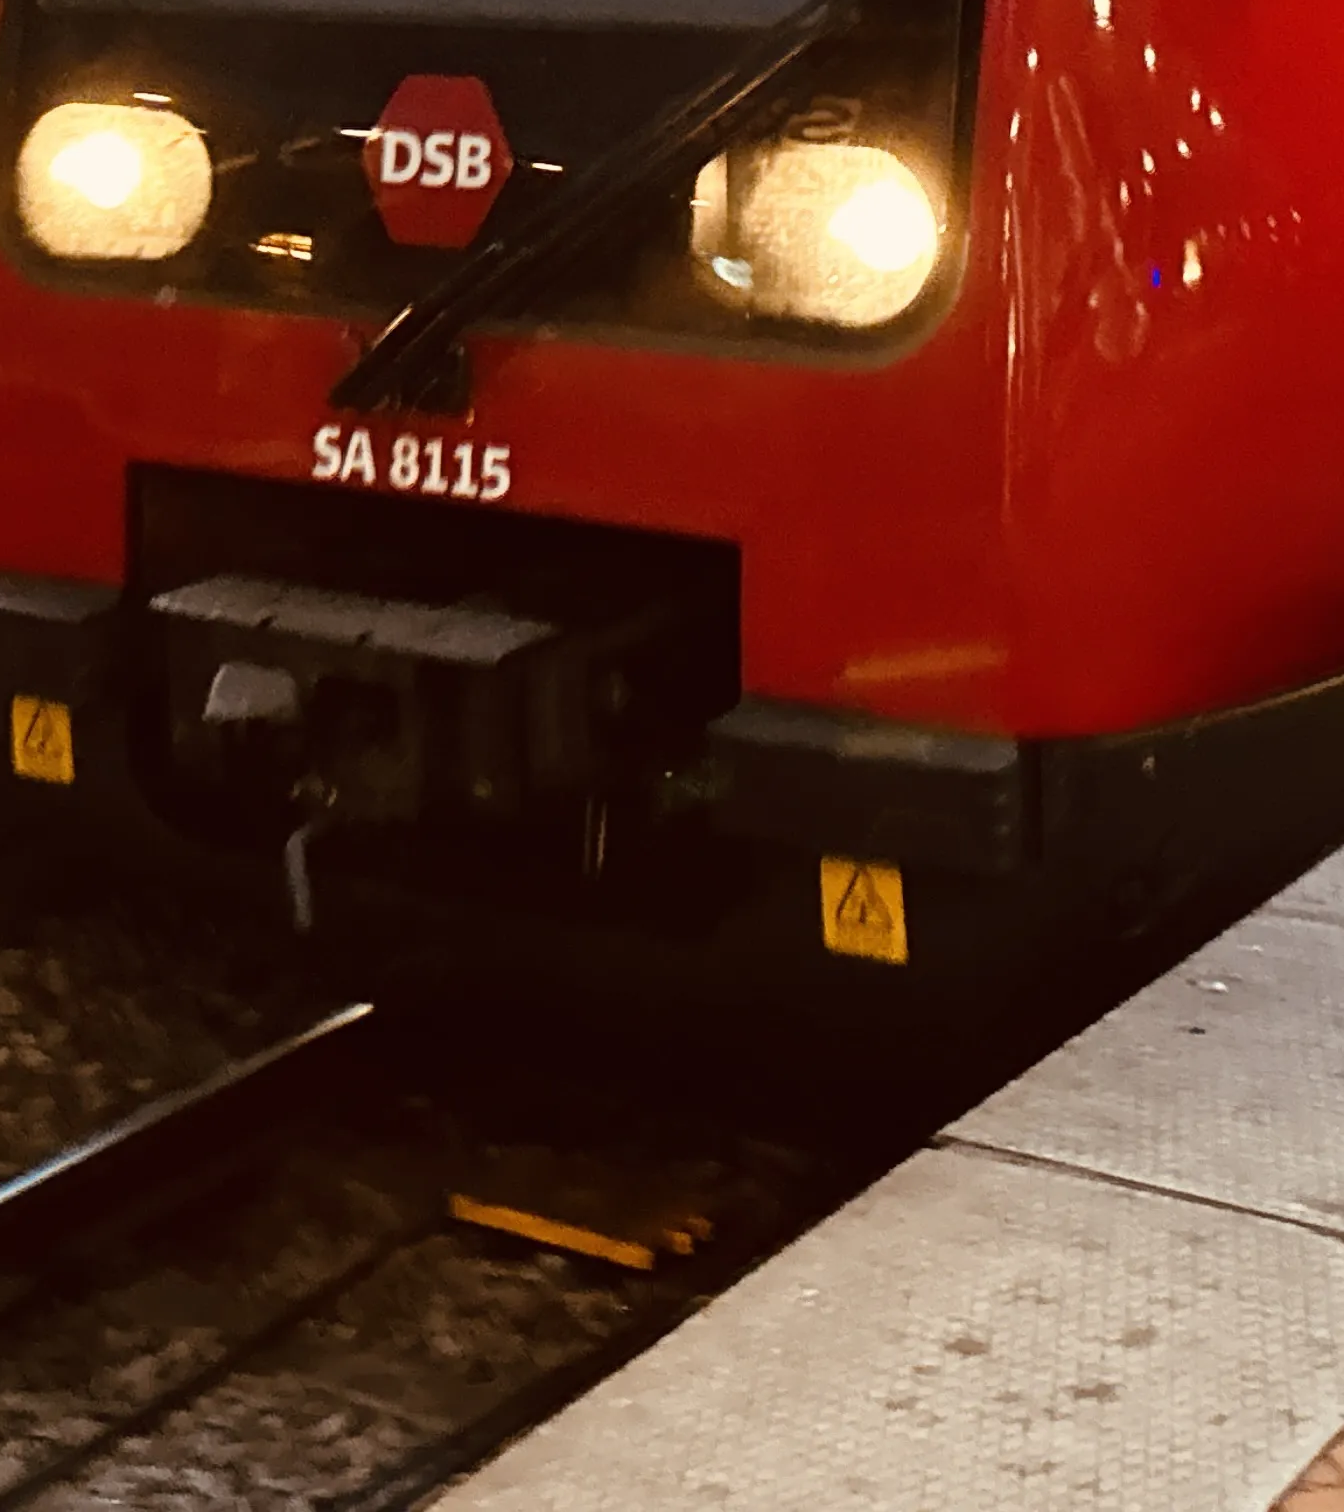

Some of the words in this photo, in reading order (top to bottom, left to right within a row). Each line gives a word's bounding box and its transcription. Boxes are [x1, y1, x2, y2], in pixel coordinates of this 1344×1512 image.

[379, 130, 492, 189] DSB
[311, 423, 376, 486] SA
[388, 432, 511, 502] 8115
